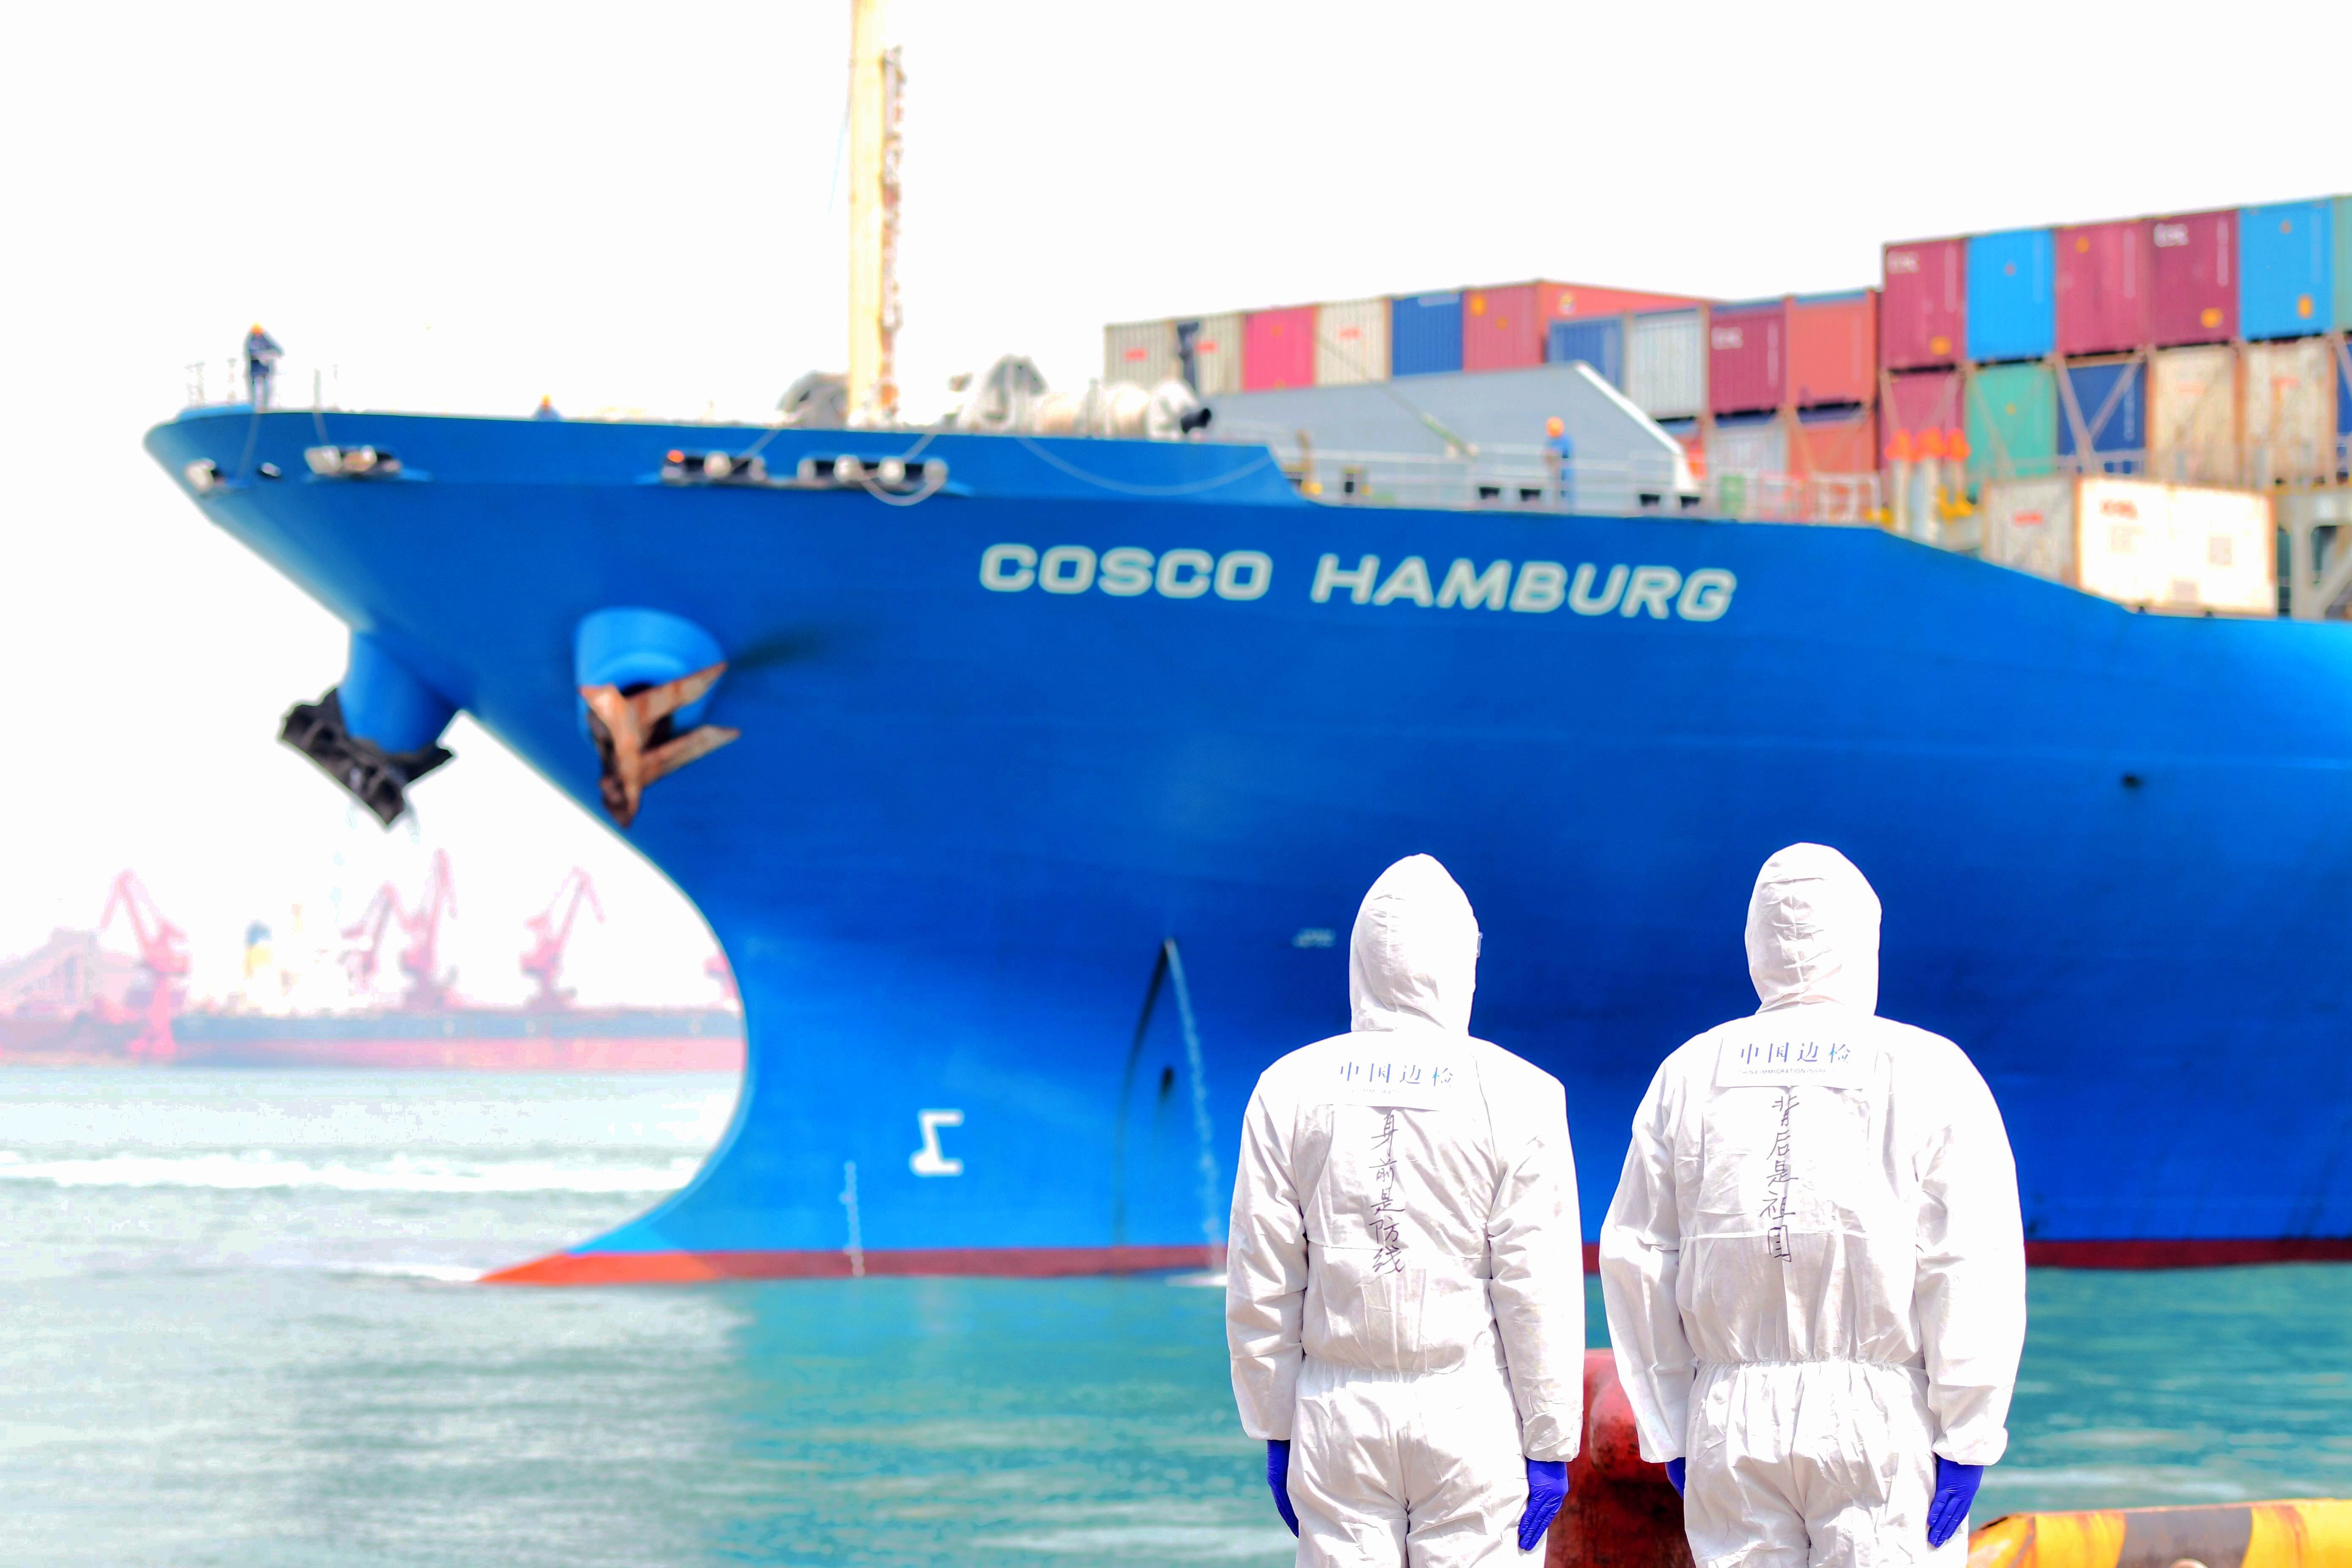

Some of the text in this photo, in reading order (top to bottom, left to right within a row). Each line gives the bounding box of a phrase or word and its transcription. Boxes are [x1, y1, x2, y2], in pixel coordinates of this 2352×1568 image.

[980, 544, 1736, 621] COSCO HAMBURG
[1339, 1061, 1454, 1087] 中国边检
[1740, 1041, 1851, 1065] 中国边检
[1369, 1113, 1406, 1274] 身前是防线
[1760, 1095, 1800, 1263] 背后是祖国
